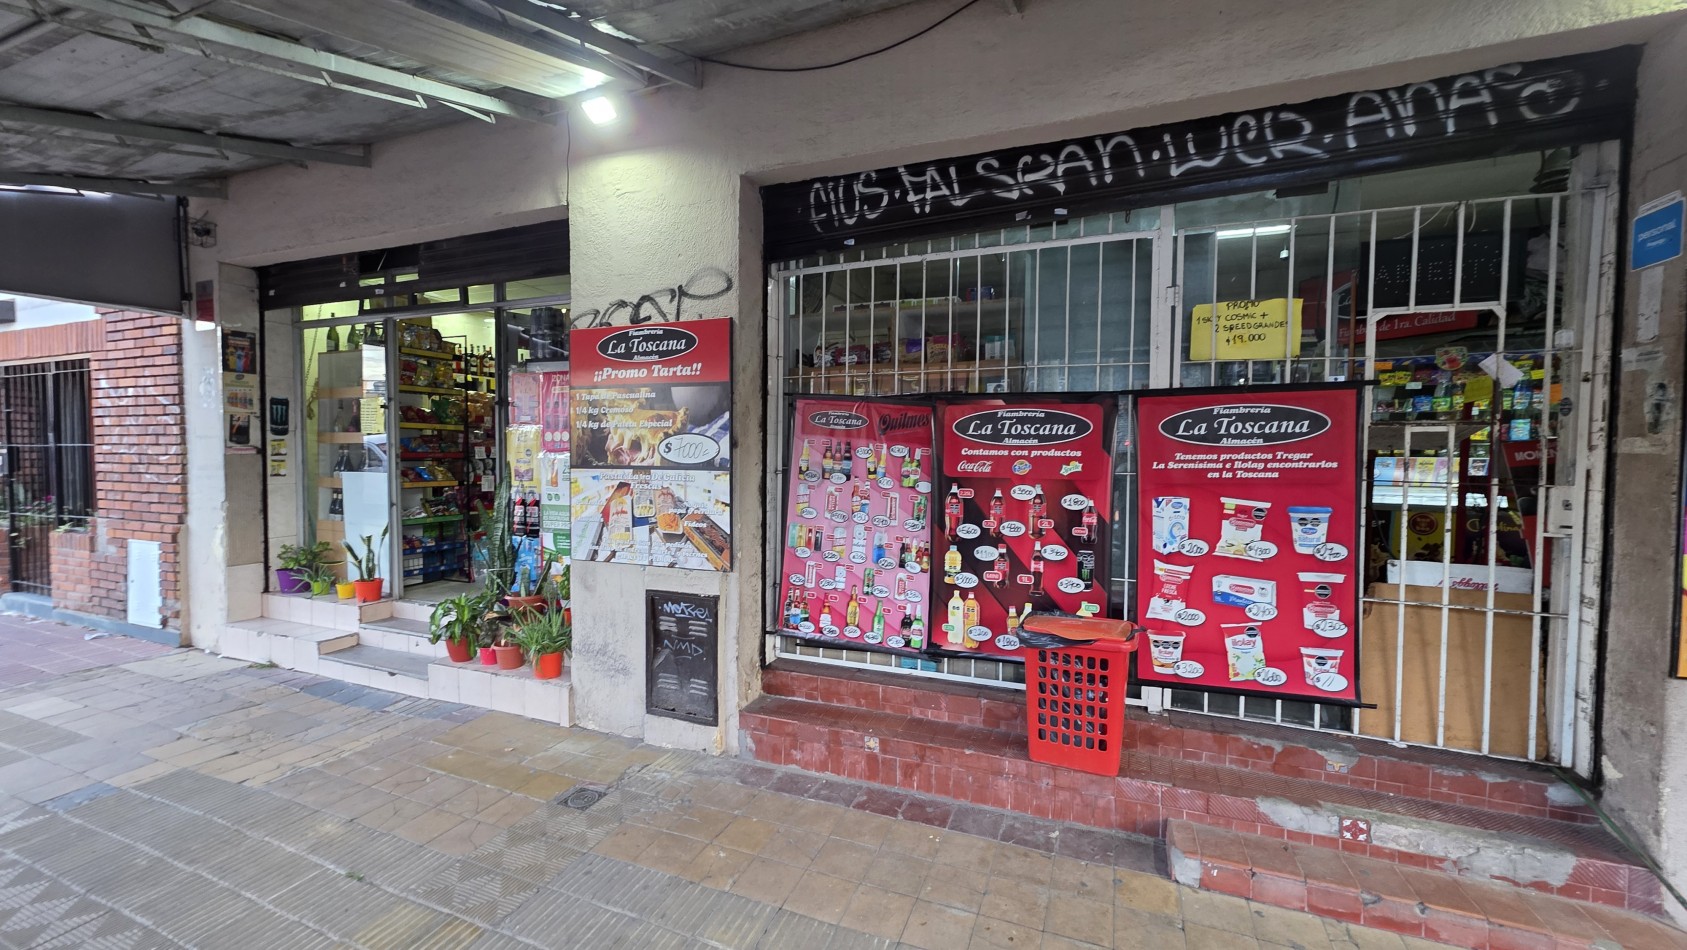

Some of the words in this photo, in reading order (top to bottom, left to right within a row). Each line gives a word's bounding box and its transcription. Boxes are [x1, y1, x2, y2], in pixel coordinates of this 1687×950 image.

[1414, 312, 1456, 328] Calidad
[607, 340, 625, 354] La
[629, 337, 686, 353] Toscana
[651, 362, 702, 378] Tarta!!
[588, 407, 598, 416] kg
[600, 406, 634, 414] Cremoso
[576, 420, 587, 428] 1/4
[588, 420, 598, 430] kg
[639, 419, 672, 429] Especial
[814, 415, 827, 423] La
[828, 415, 862, 426] Toscana
[878, 412, 931, 436] Quilmes
[1175, 418, 1207, 436] La
[1213, 415, 1311, 436] Toscana
[966, 420, 993, 435] La
[998, 418, 1076, 436] Toscana
[1219, 437, 1264, 445] Almacén
[961, 447, 1009, 456] Contamos
[1031, 449, 1082, 457] productos
[1175, 452, 1218, 461] Tenemos
[1219, 452, 1273, 462] productos
[1276, 452, 1313, 462] Tregar
[1152, 461, 1165, 470] La
[1167, 461, 1223, 470] Serenísima
[1267, 461, 1339, 469] encontrarlos
[1235, 470, 1279, 479] Toscana
[684, 520, 706, 529] Fideos
